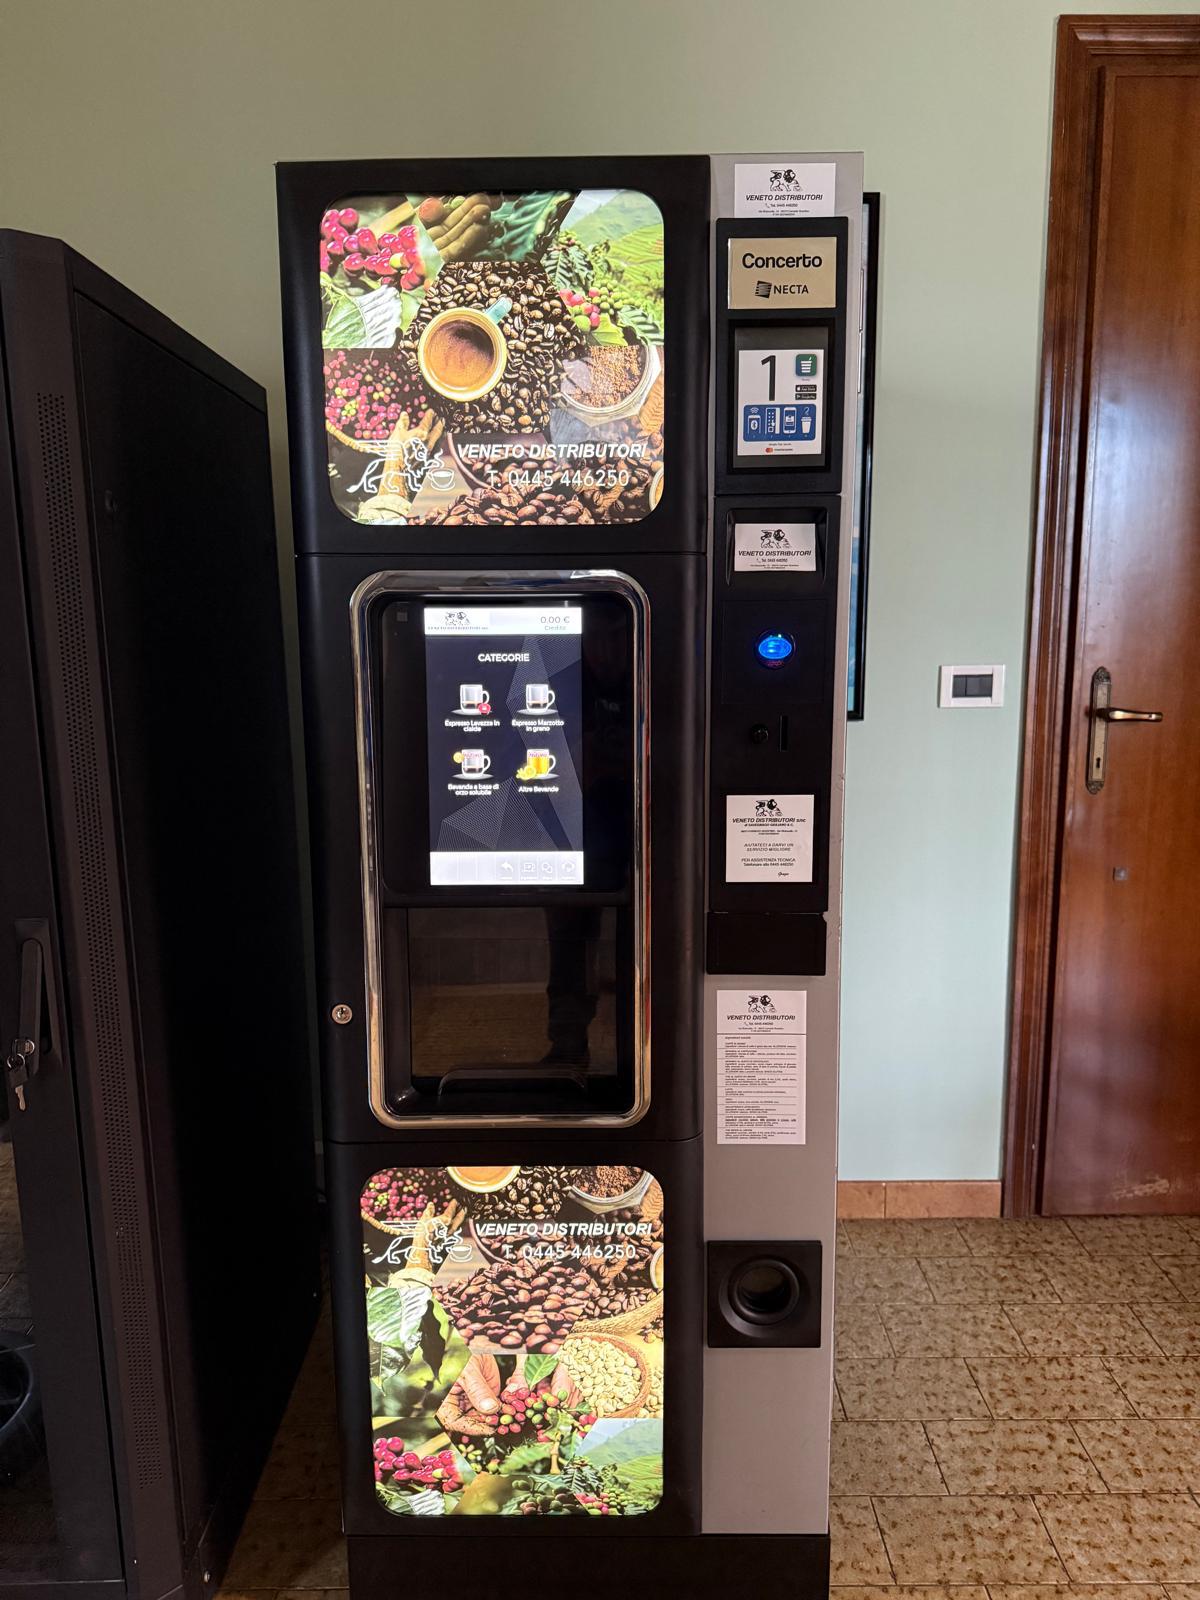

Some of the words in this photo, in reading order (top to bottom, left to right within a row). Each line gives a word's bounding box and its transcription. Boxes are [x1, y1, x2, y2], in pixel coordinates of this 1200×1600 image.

[742, 252, 822, 269] Concerto
[773, 284, 809, 294] NECTA
[761, 355, 776, 401] 1
[457, 444, 525, 458] VENETO
[529, 444, 647, 458] DISTRIBUTORI
[488, 470, 502, 487] T.
[508, 470, 554, 487] 0445
[560, 470, 629, 487] 446250
[478, 653, 530, 662] CATEGORIE
[475, 1223, 538, 1236] VENETO
[542, 1223, 652, 1236] DISTRIBUTORI
[502, 1245, 516, 1259] T.
[523, 1245, 565, 1259] 0445
[571, 1245, 636, 1259] 446250
